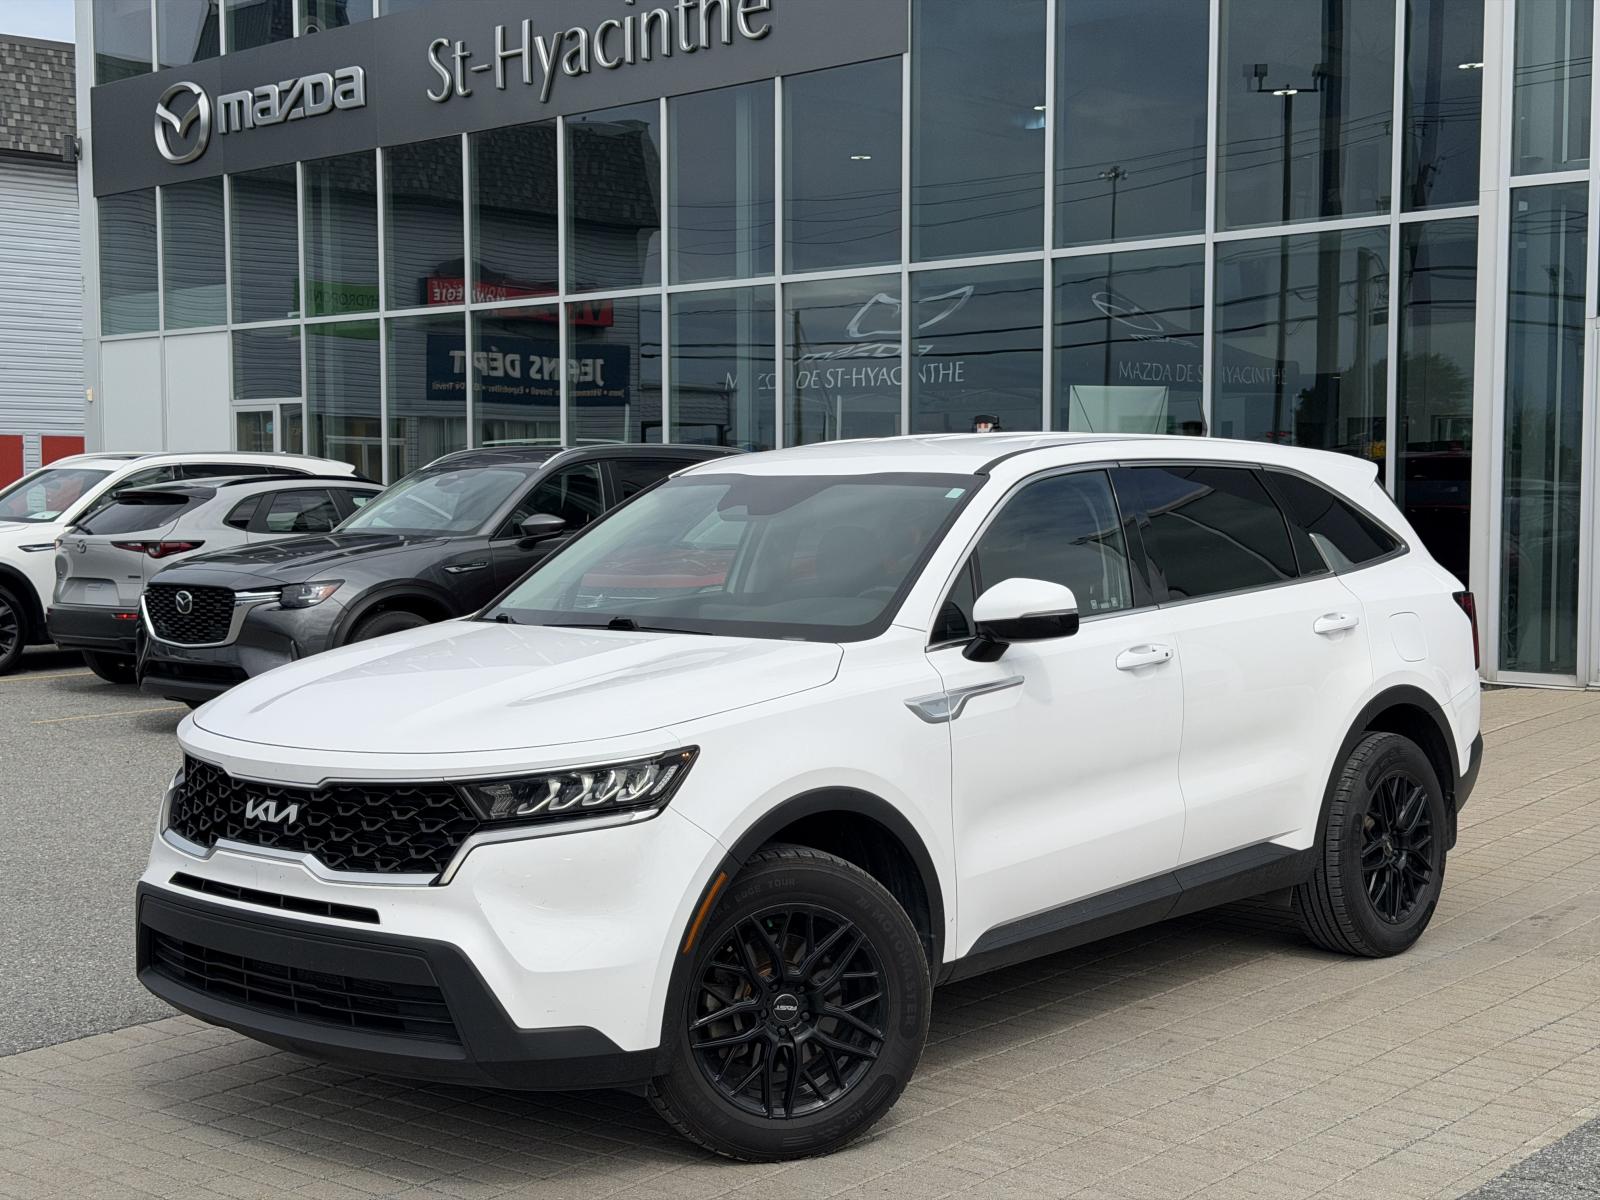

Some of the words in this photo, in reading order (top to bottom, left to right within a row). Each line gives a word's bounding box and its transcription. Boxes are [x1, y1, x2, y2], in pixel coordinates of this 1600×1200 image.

[427, 0, 772, 103] St-Hyacinthe
[796, 370, 820, 389] DE
[825, 361, 965, 388] ST-HYACNTHE
[1119, 360, 1173, 382] MAZDA
[1176, 363, 1193, 382] DE
[245, 798, 298, 825] KIA
